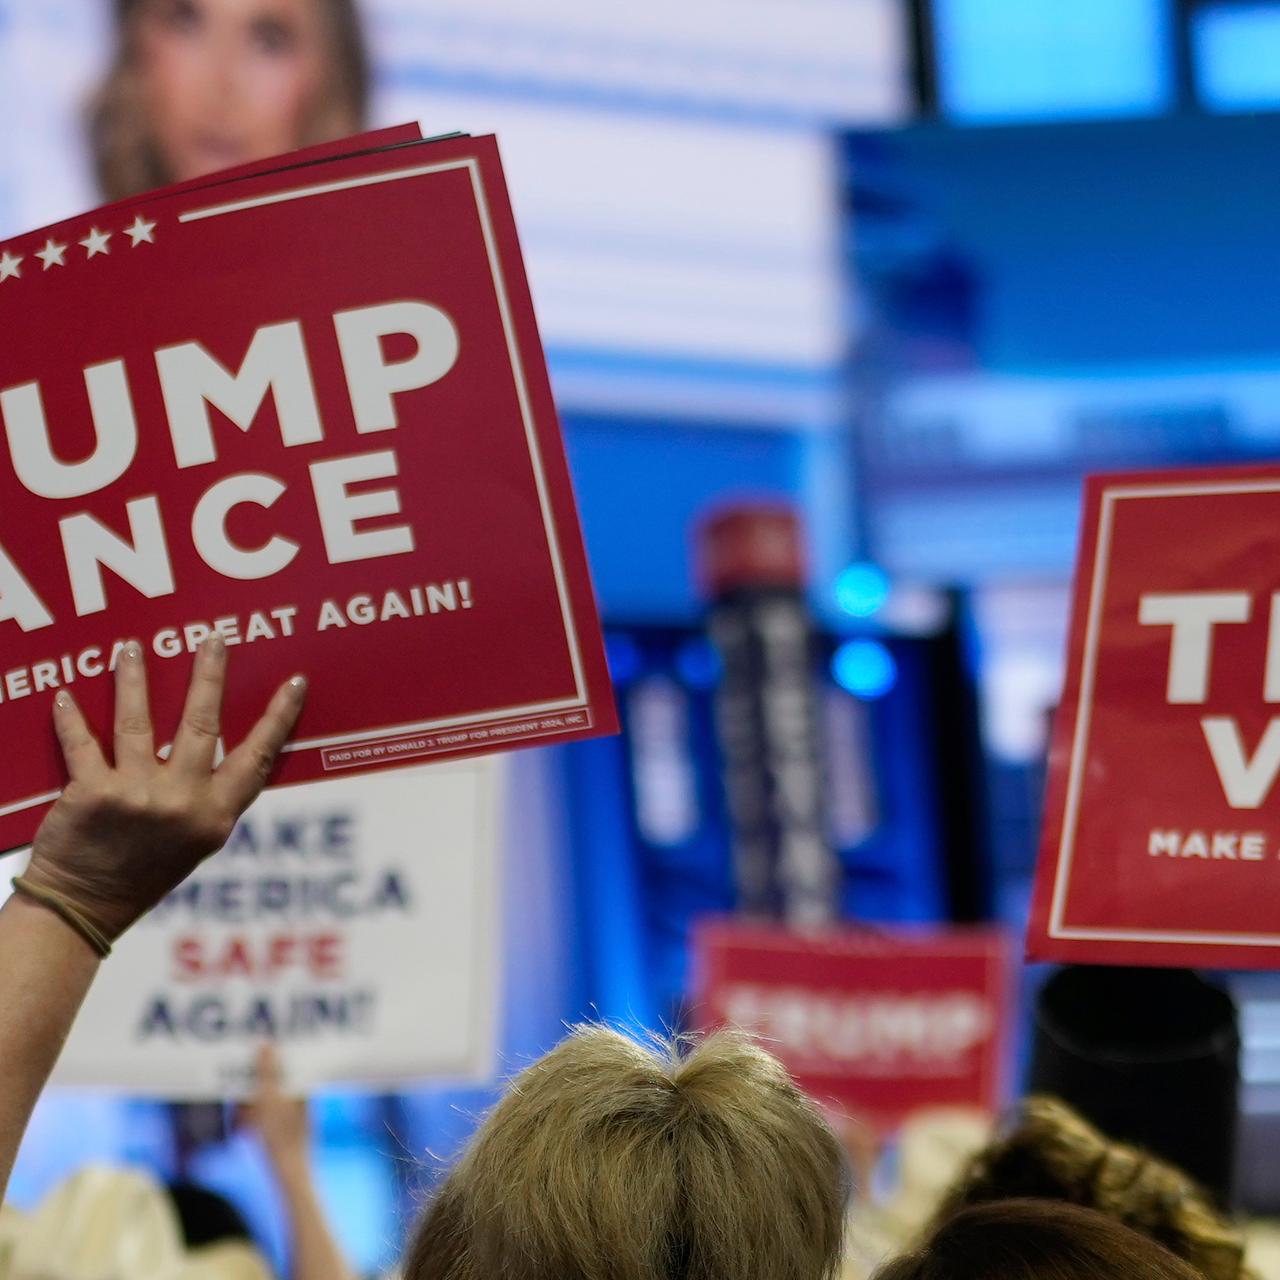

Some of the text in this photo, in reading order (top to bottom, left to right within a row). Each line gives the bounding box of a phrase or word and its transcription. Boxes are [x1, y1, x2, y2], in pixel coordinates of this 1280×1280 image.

[316, 580, 473, 632] AGAIN!
[328, 752, 352, 763] PAID
[353, 748, 372, 759] FOR
[373, 746, 387, 756] BY
[387, 740, 426, 753] DONALD
[437, 734, 468, 746] TRUMP
[469, 731, 489, 741] FOR
[489, 722, 539, 737] PRESIDENT
[222, 813, 355, 857] AKE
[1146, 829, 1267, 863] MAKE
[173, 932, 346, 982] SAFE
[138, 992, 376, 1042] AGAIN!
